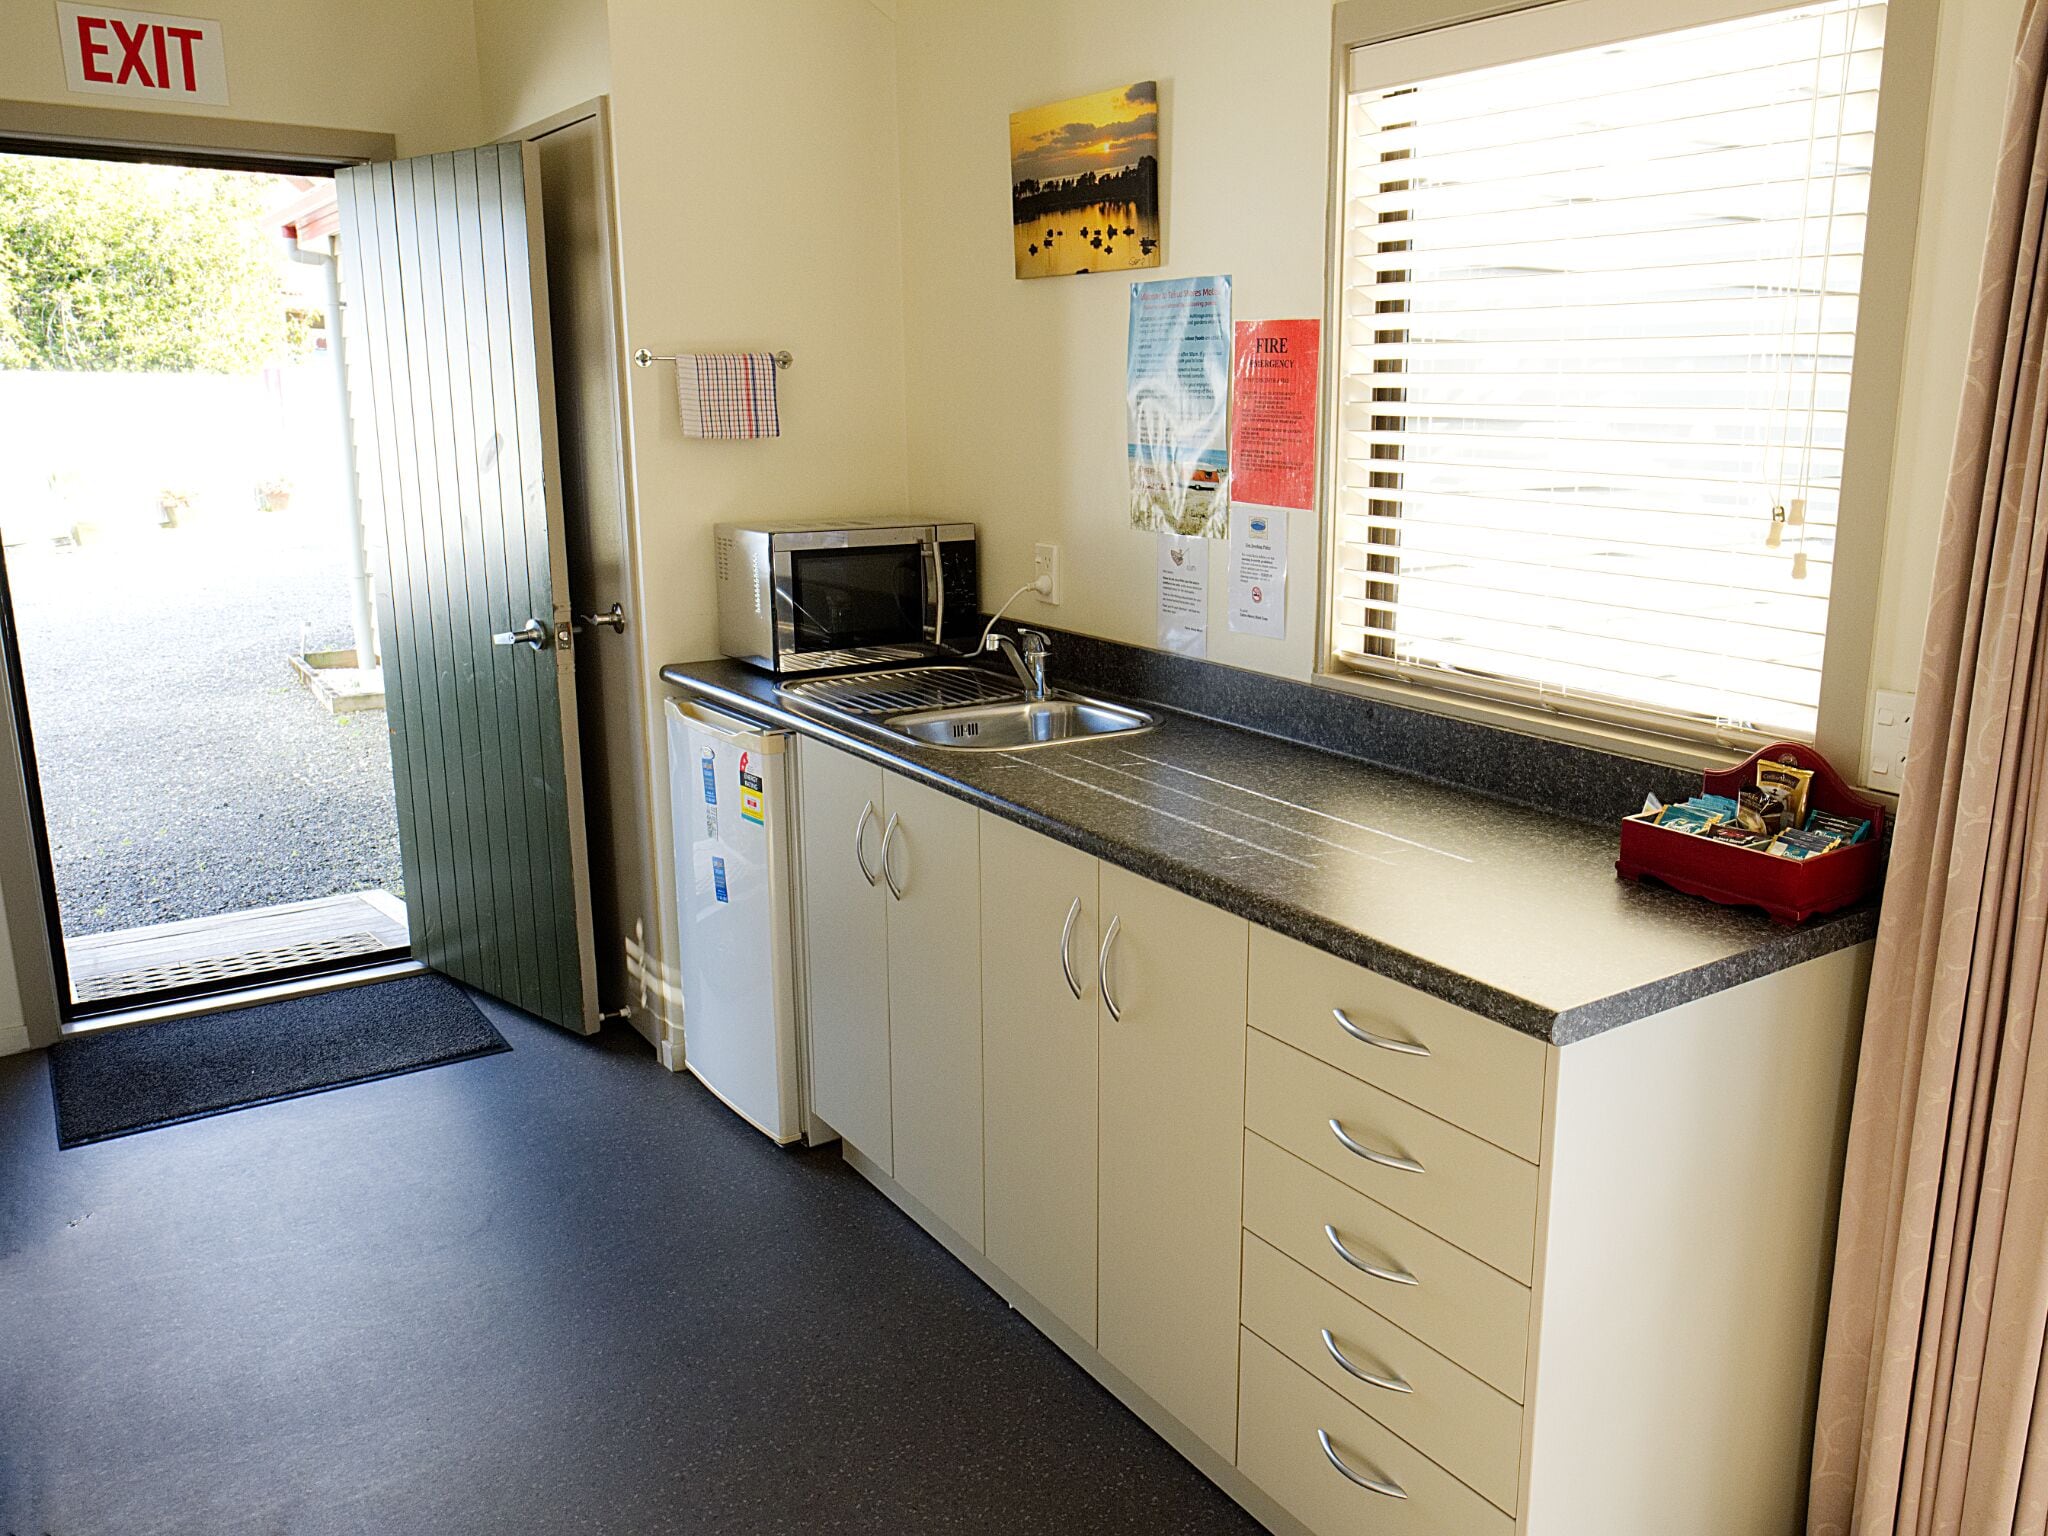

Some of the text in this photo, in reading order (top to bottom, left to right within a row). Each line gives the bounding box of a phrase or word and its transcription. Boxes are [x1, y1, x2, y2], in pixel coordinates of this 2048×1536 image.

[77, 16, 203, 92] EXIT
[1256, 337, 1288, 354] FIRE
[1249, 359, 1295, 369] EMERGENCY
